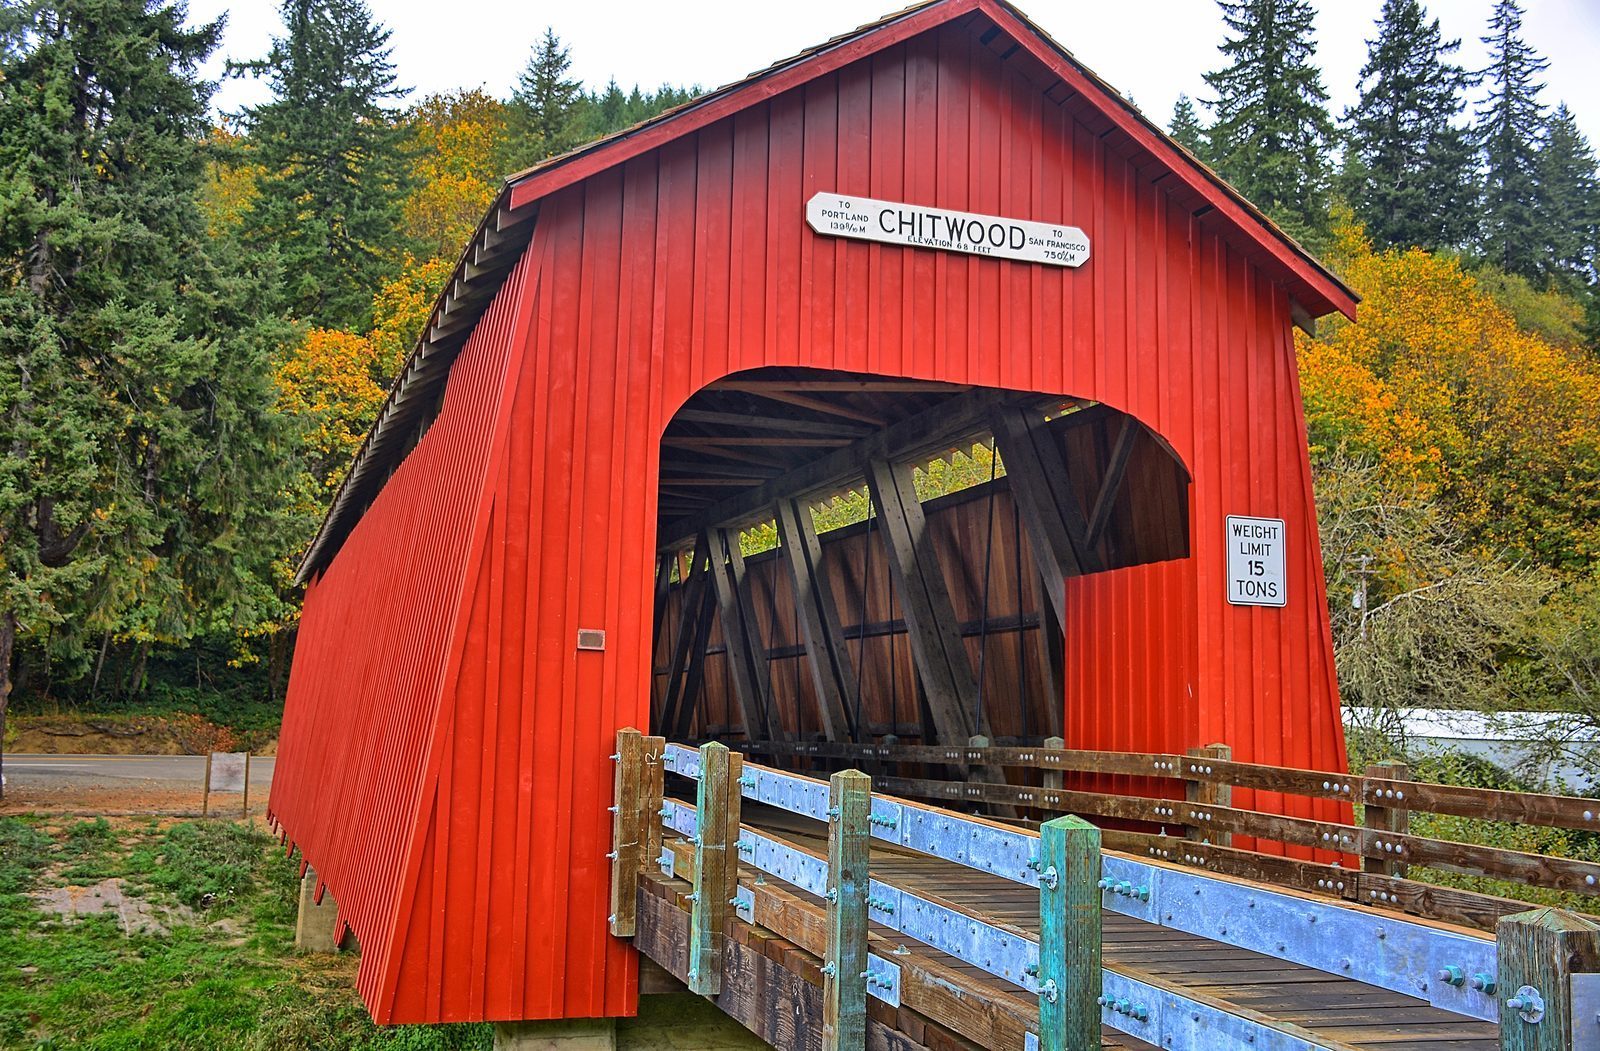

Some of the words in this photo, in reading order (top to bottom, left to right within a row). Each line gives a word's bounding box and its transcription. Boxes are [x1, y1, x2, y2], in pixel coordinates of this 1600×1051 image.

[838, 201, 851, 209] TO
[821, 209, 869, 222] PORTLAND
[879, 209, 1026, 250] CHITWOOD
[1053, 229, 1063, 238] TO
[907, 235, 953, 248] ELEVATION
[973, 245, 991, 254] FEET
[1028, 237, 1044, 246] SAN
[1046, 240, 1086, 252] FRANCISCO
[1232, 524, 1278, 539] WEIGHT
[1240, 542, 1271, 556] LIMIT
[1248, 560, 1265, 576] 15
[1236, 579, 1278, 598] TONS
